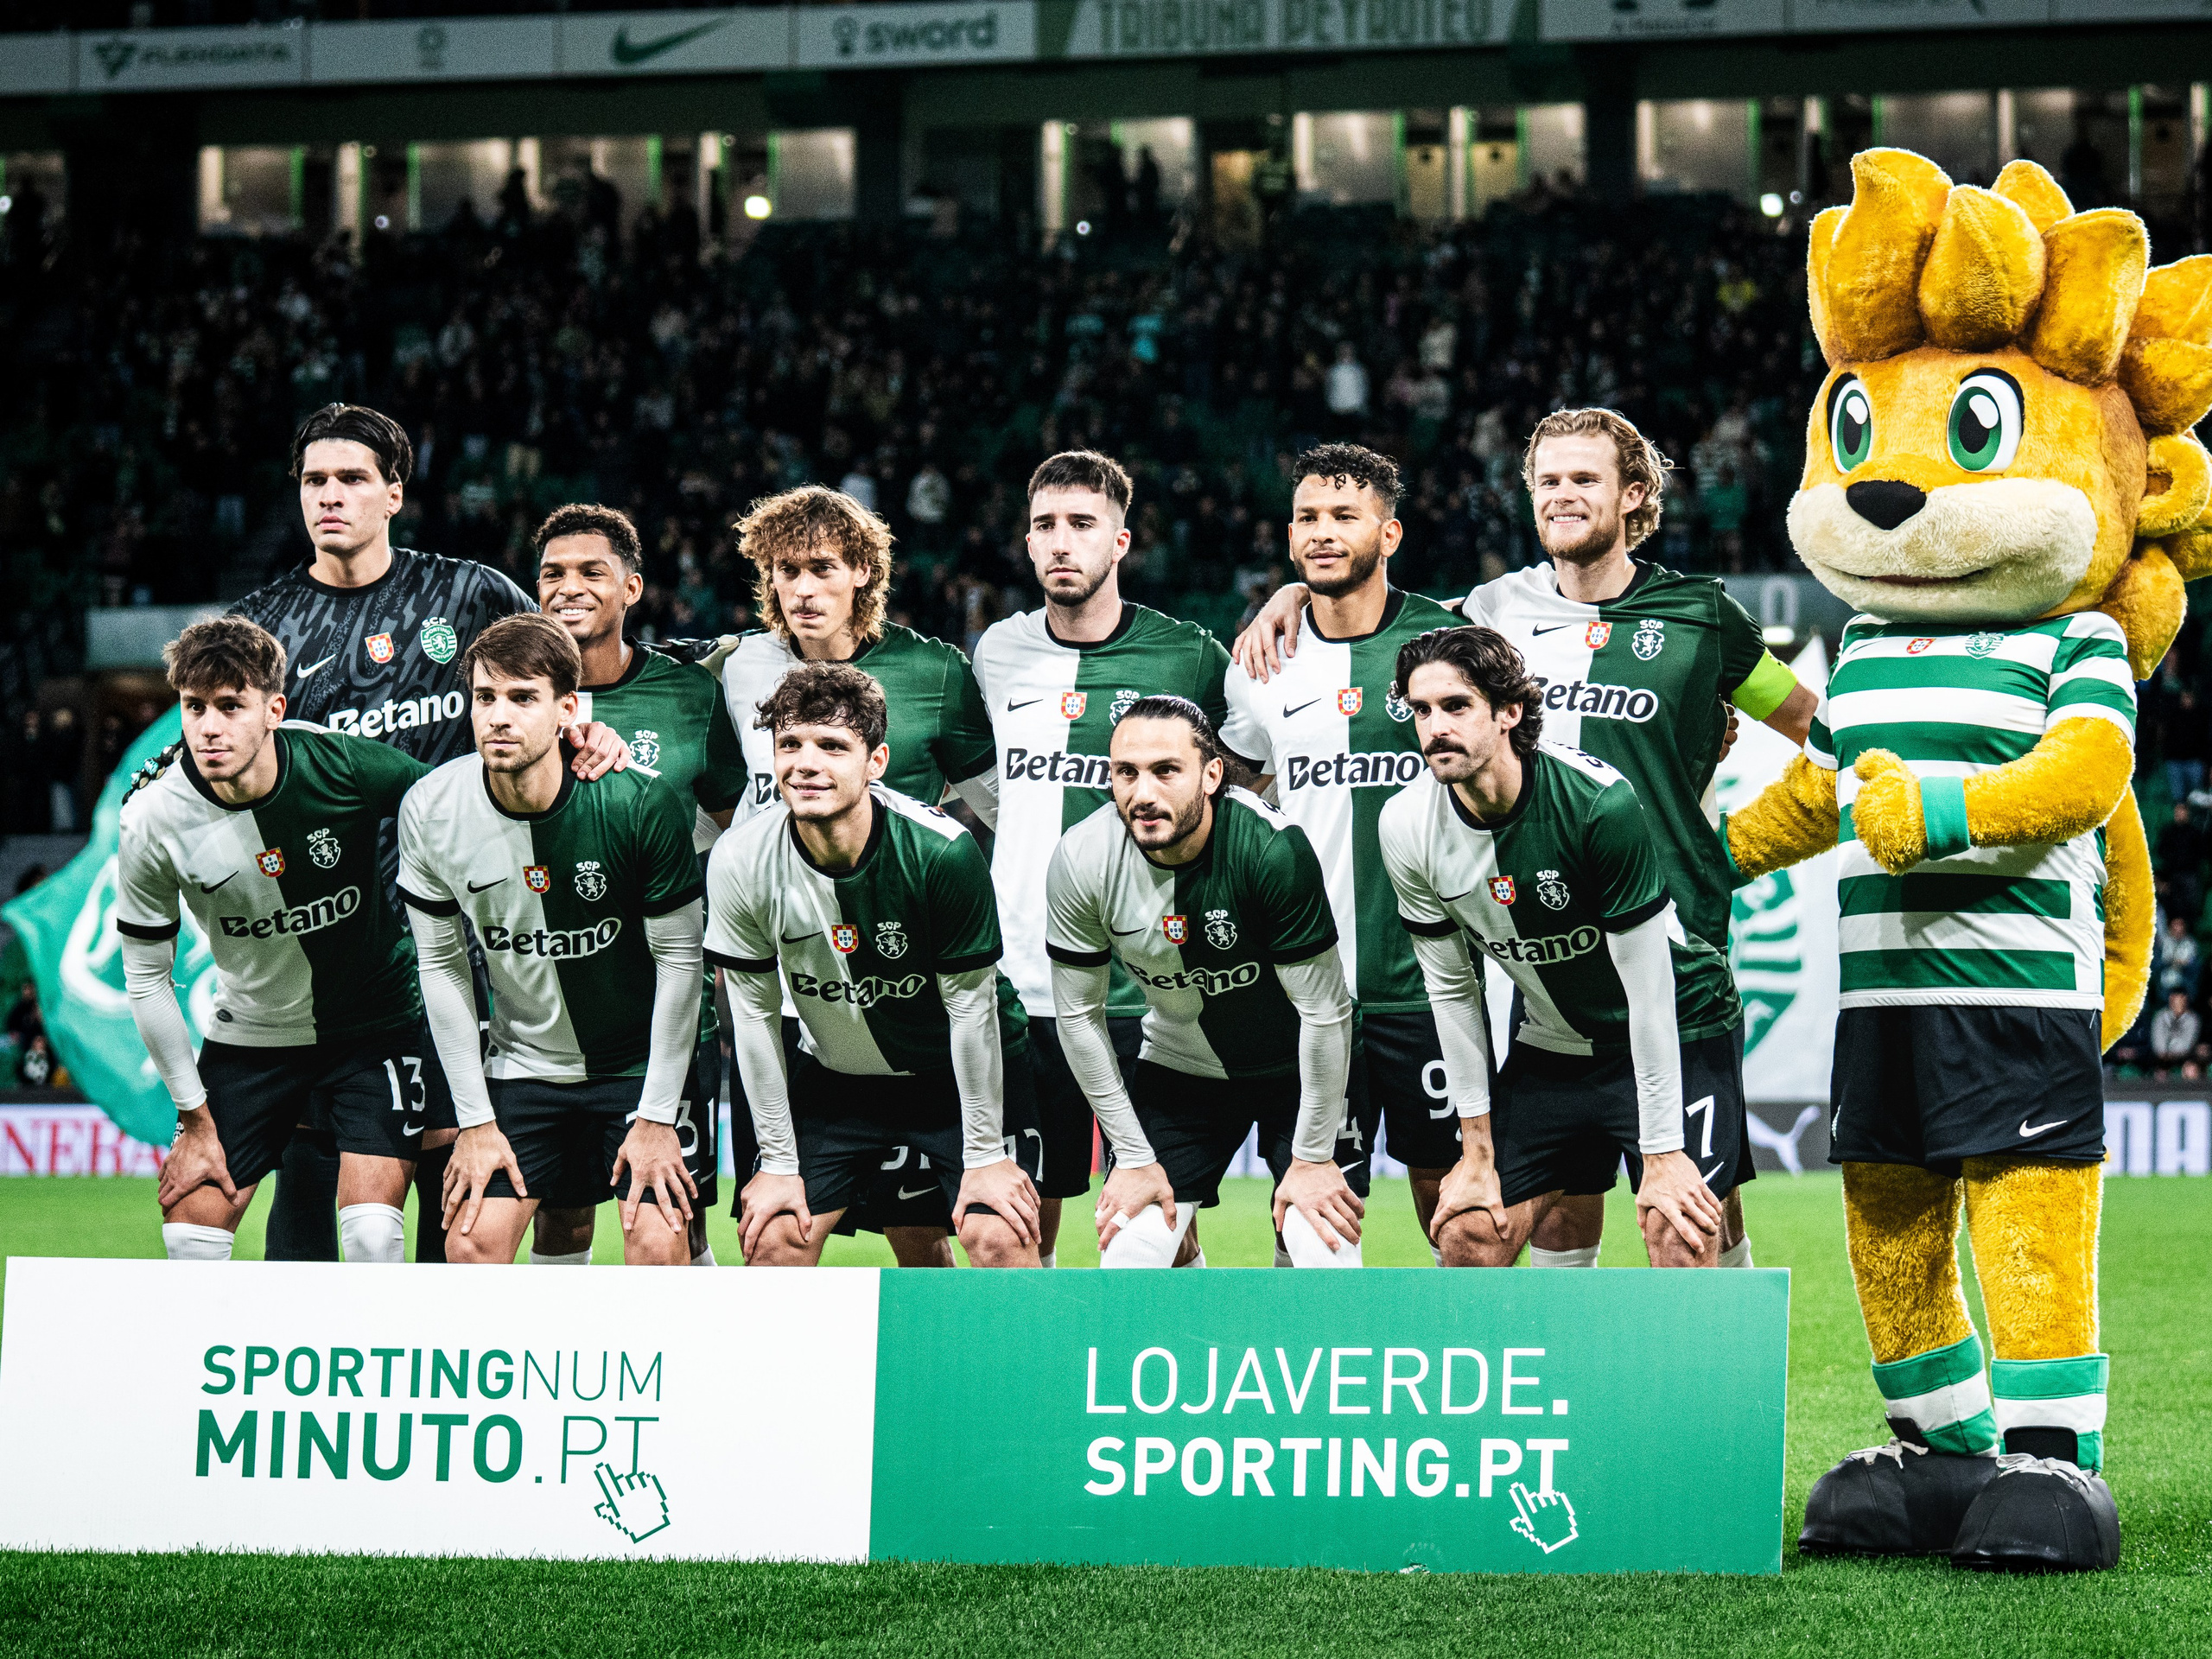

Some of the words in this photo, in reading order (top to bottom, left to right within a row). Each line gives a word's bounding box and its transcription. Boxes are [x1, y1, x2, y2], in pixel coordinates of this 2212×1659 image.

[865, 9, 999, 54] sword
[422, 616, 448, 628] SCP
[1639, 620, 1664, 630] SCP
[1116, 690, 1140, 700] SCP
[329, 690, 465, 738] Betano
[634, 729, 658, 740] SCP
[1006, 747, 1112, 786] Betan
[1287, 752, 1421, 791] Betano
[306, 828, 330, 843] SCP
[575, 861, 601, 872] SCP
[1536, 869, 1560, 880] SCP
[219, 887, 359, 939] Betano
[877, 921, 901, 931] SCP
[1205, 909, 1229, 920] SCP
[483, 918, 620, 958] Betano
[791, 971, 925, 1007] Betano
[383, 1056, 425, 1112] 13
[1085, 1347, 1568, 1416] LOJAVERDE.
[194, 1409, 661, 1486] MINUTO.PT
[1084, 1435, 1569, 1498] SPORTING.PT
